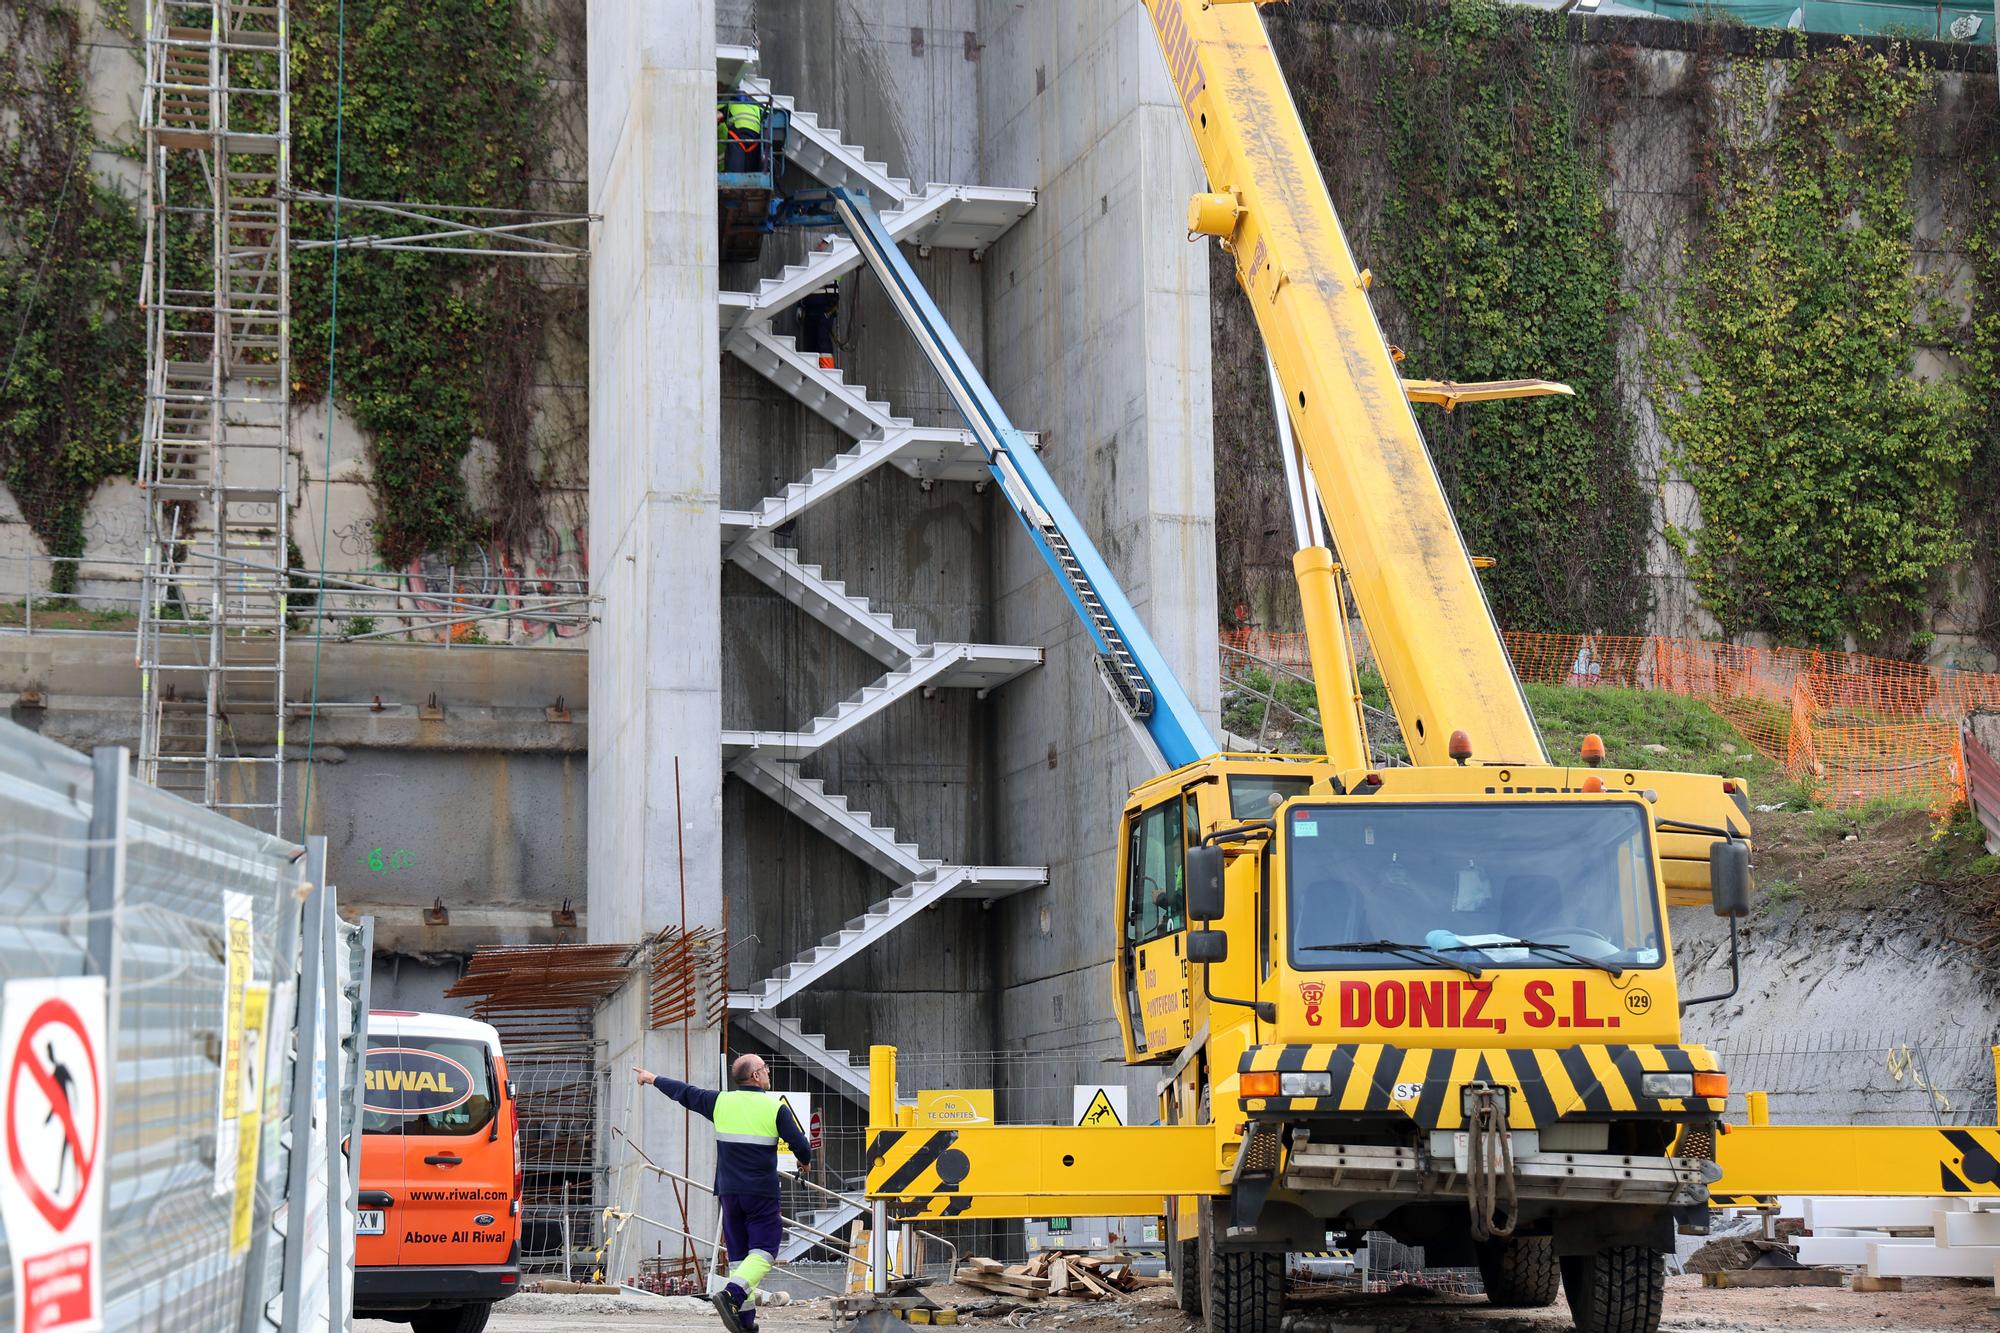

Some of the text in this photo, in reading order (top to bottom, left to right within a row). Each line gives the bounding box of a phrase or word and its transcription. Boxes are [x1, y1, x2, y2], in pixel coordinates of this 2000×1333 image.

[1340, 980, 1621, 1034] DONIZ, S.L.
[1628, 994, 1649, 1008] 129
[364, 1070, 454, 1093] RIWAL
[928, 1111, 974, 1119] TE CONFIES
[410, 1188, 508, 1201] www.riwal.com
[357, 1212, 379, 1229] XW
[404, 1230, 506, 1243] Above All Riwal
